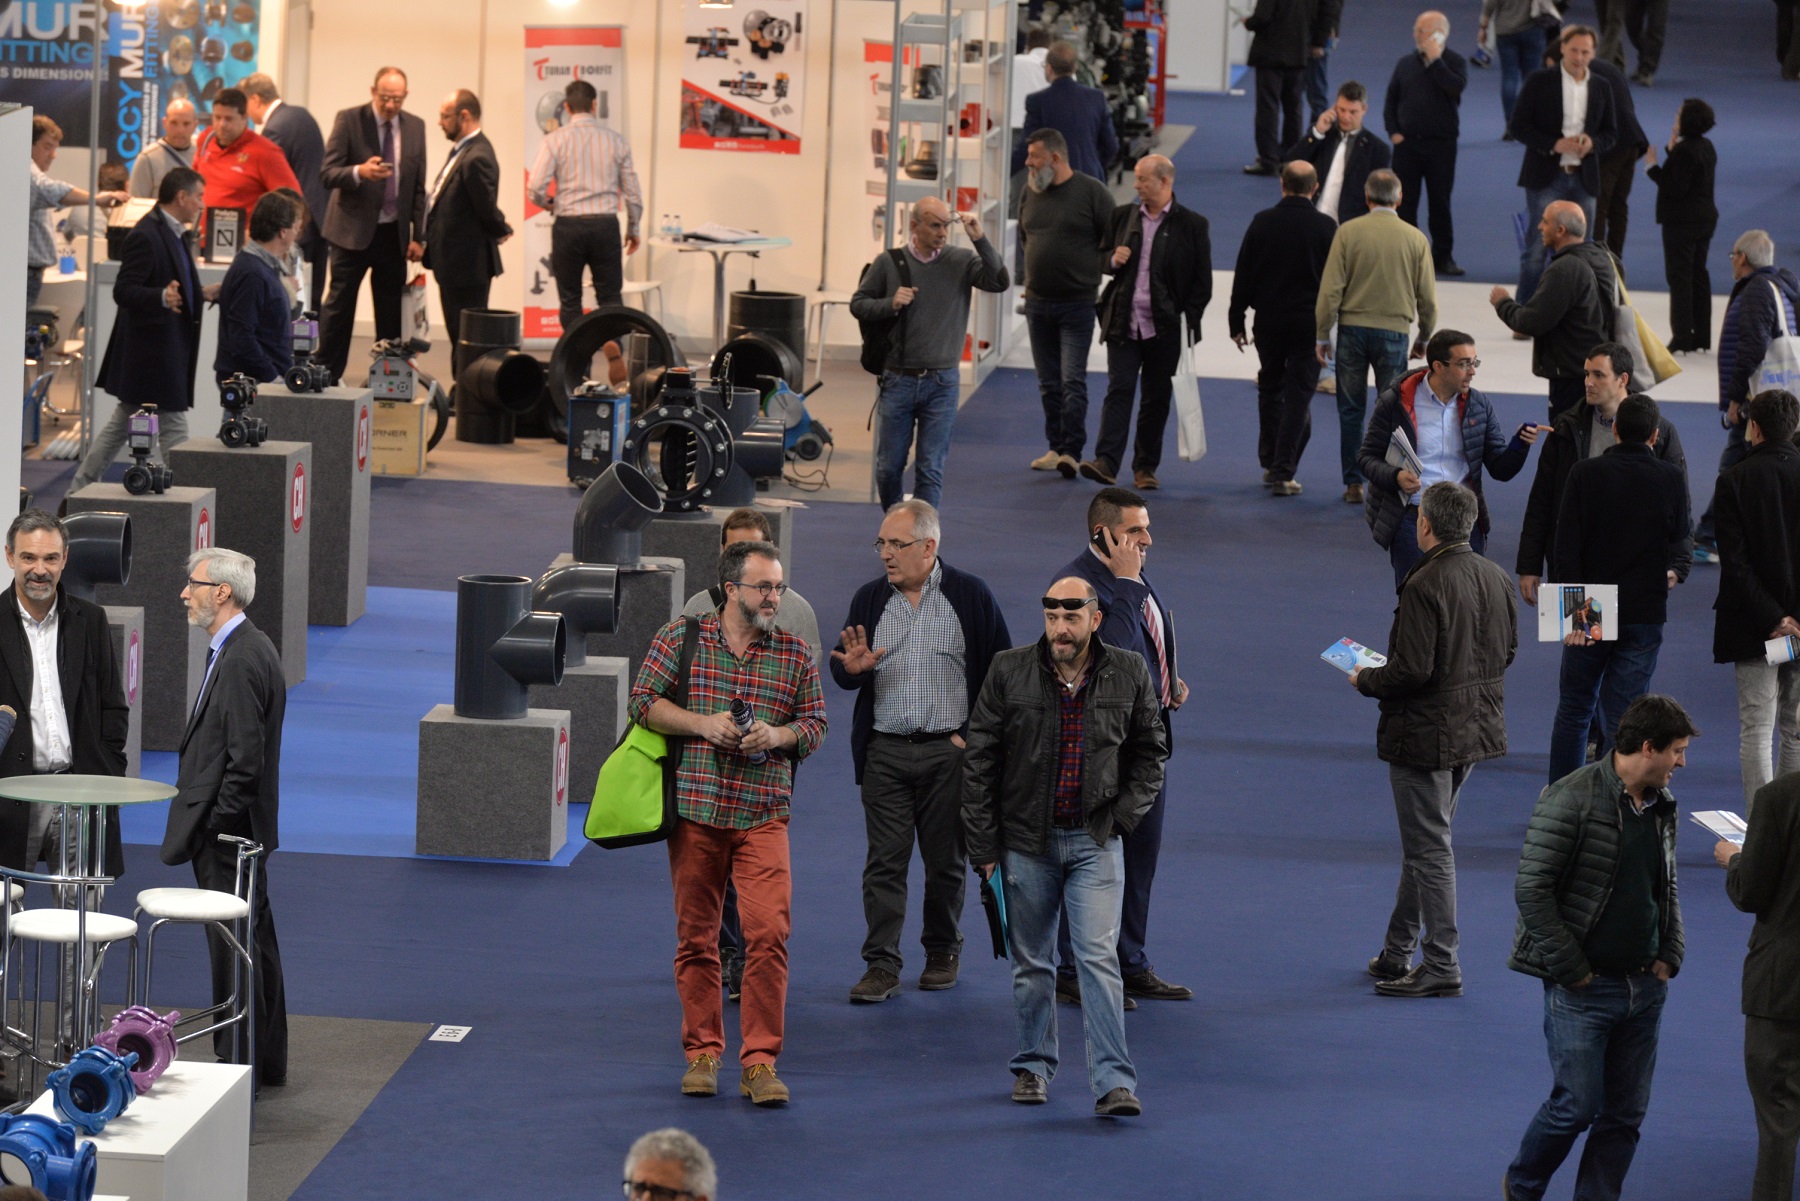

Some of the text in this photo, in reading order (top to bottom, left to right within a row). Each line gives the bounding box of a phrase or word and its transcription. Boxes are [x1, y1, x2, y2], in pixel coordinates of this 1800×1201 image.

[144, 0, 160, 78] FITTING
[294, 475, 304, 520] CH
[130, 642, 138, 692] CH
[557, 741, 567, 792] CH
